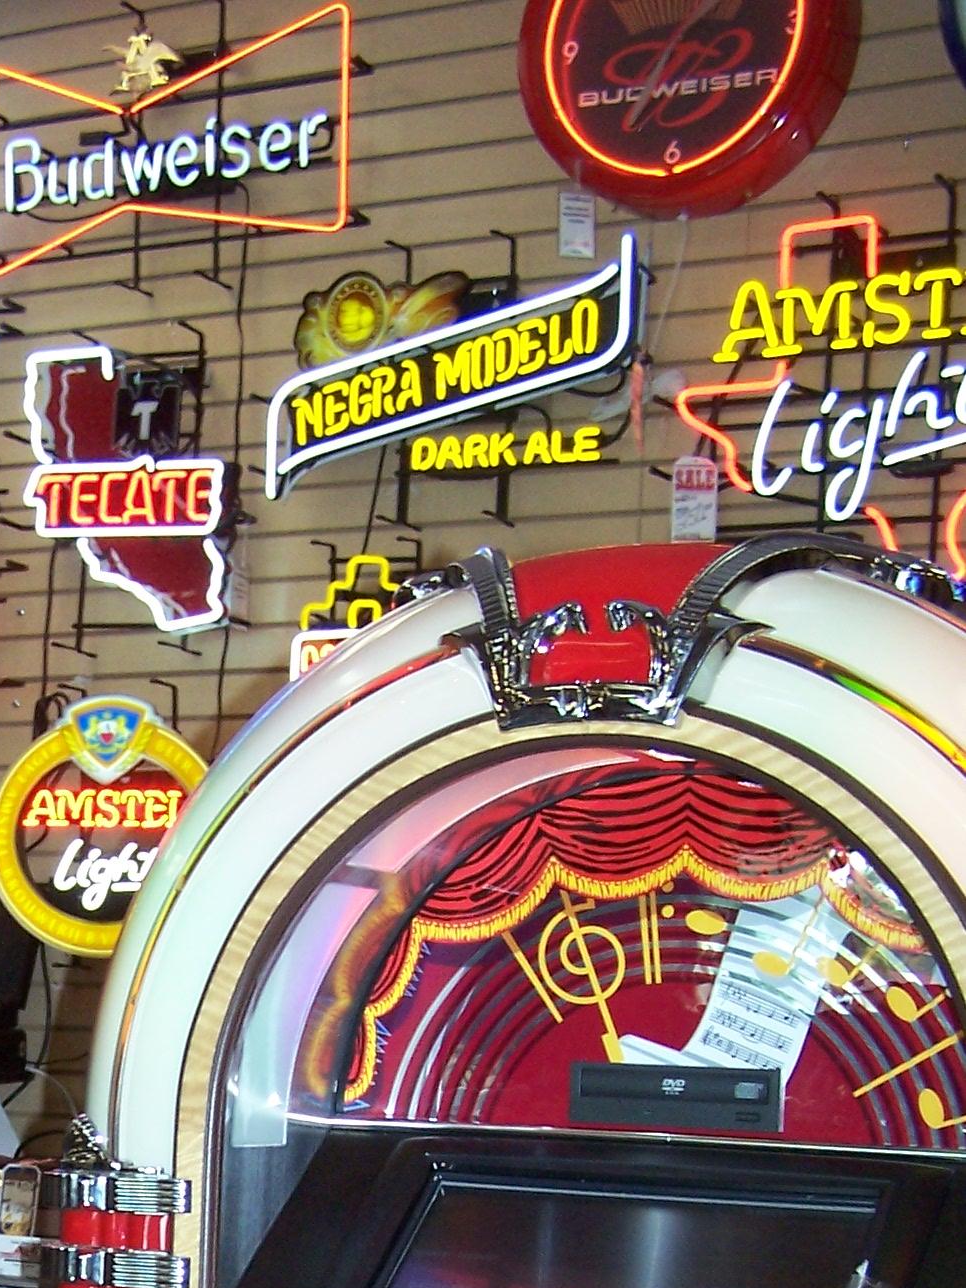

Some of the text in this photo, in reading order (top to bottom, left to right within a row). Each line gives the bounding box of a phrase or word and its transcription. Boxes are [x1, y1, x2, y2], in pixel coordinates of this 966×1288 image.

[561, 40, 579, 66] 9
[4, 112, 329, 215] Budweiser
[663, 140, 682, 165] 6
[712, 267, 966, 363] AMST
[291, 298, 600, 446] NEGRA MODELO
[410, 426, 602, 472] DARK ALE
[36, 470, 214, 527] TECATE
[661, 1078, 687, 1088] DVD
